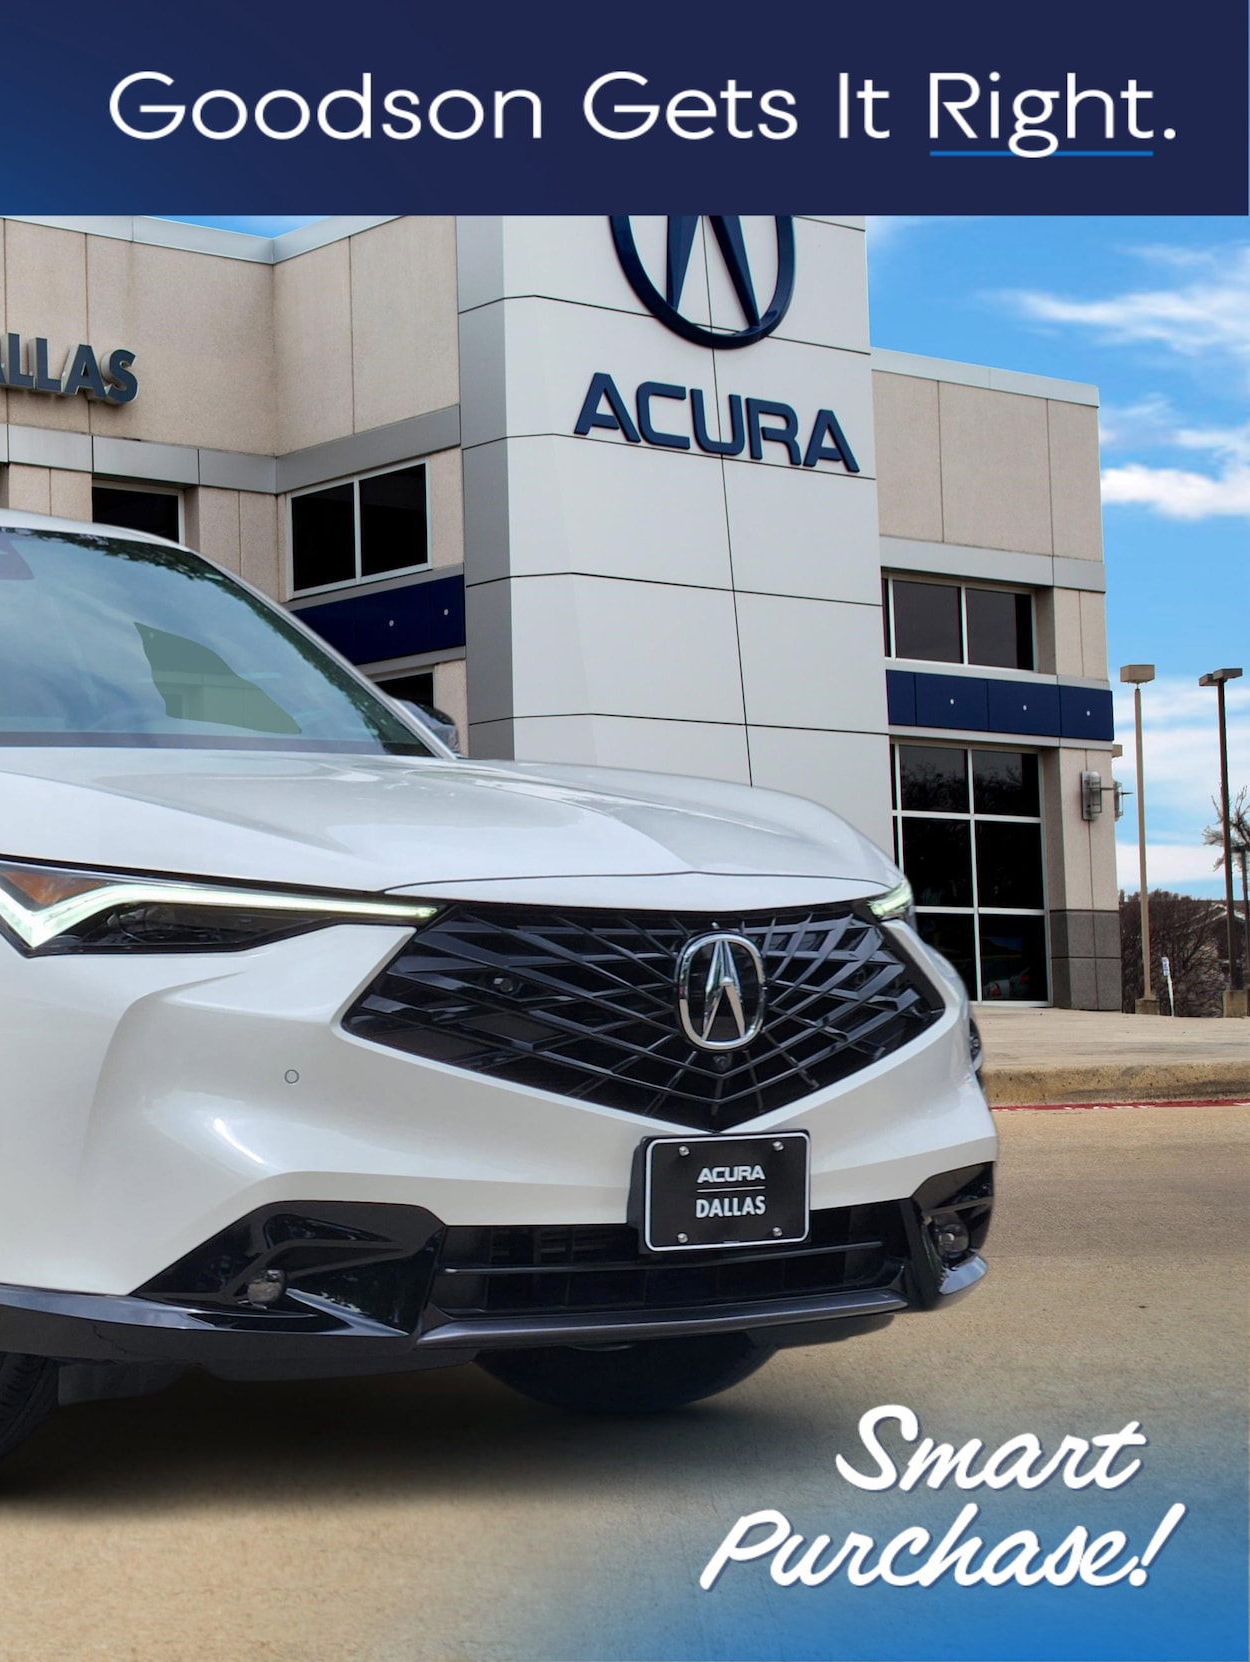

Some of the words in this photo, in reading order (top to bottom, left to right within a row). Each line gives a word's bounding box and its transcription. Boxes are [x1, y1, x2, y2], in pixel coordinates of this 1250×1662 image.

[574, 372, 860, 474] ACURA
[697, 1164, 766, 1184] ACURA
[695, 1195, 767, 1219] DALLAS
